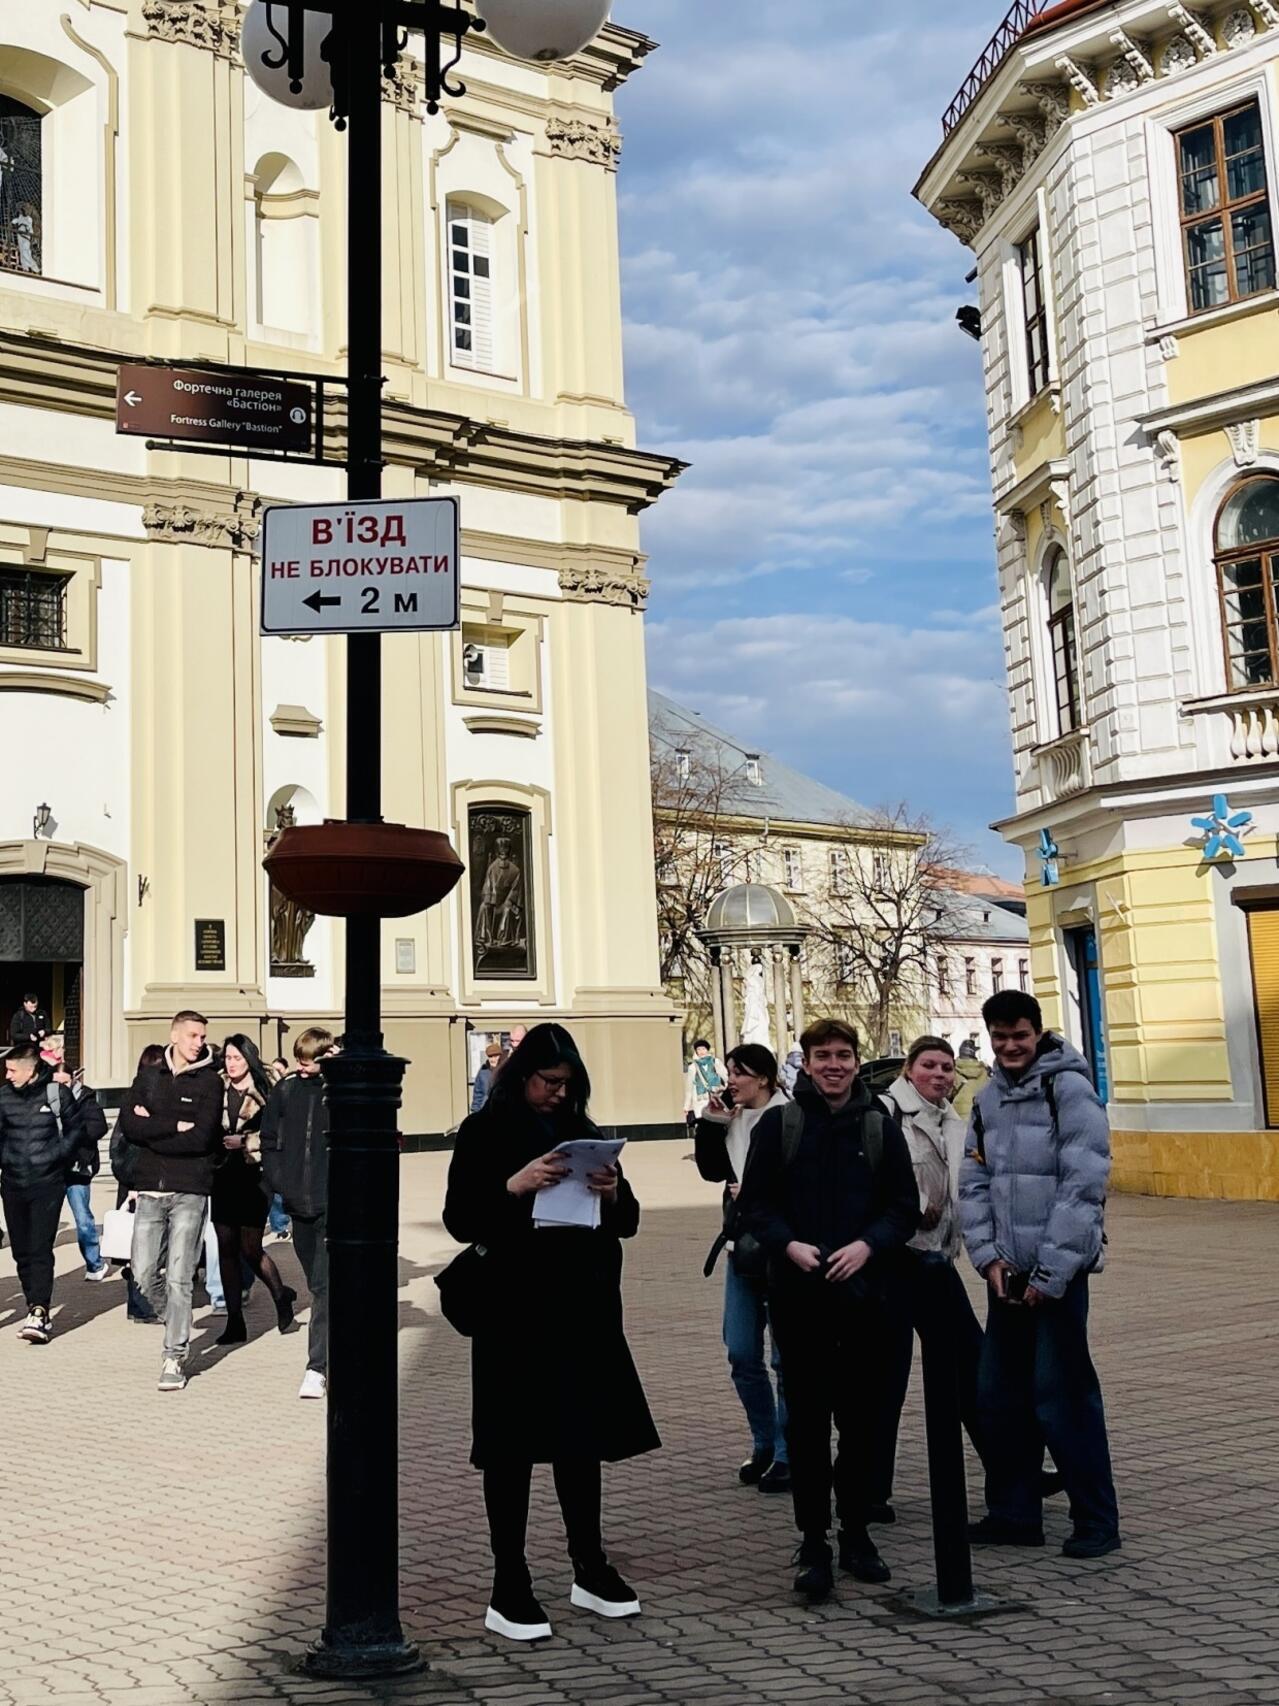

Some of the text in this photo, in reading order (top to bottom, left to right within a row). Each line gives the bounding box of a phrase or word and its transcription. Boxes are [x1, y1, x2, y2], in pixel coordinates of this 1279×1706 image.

[173, 379, 282, 401] Фортечна галерея
[170, 414, 207, 427] Fortress
[208, 418, 241, 431] Gallery
[312, 511, 407, 547] В'ЇЗД
[271, 555, 449, 578] НЕ БЛОКУВАТИ
[360, 587, 380, 614] 2
